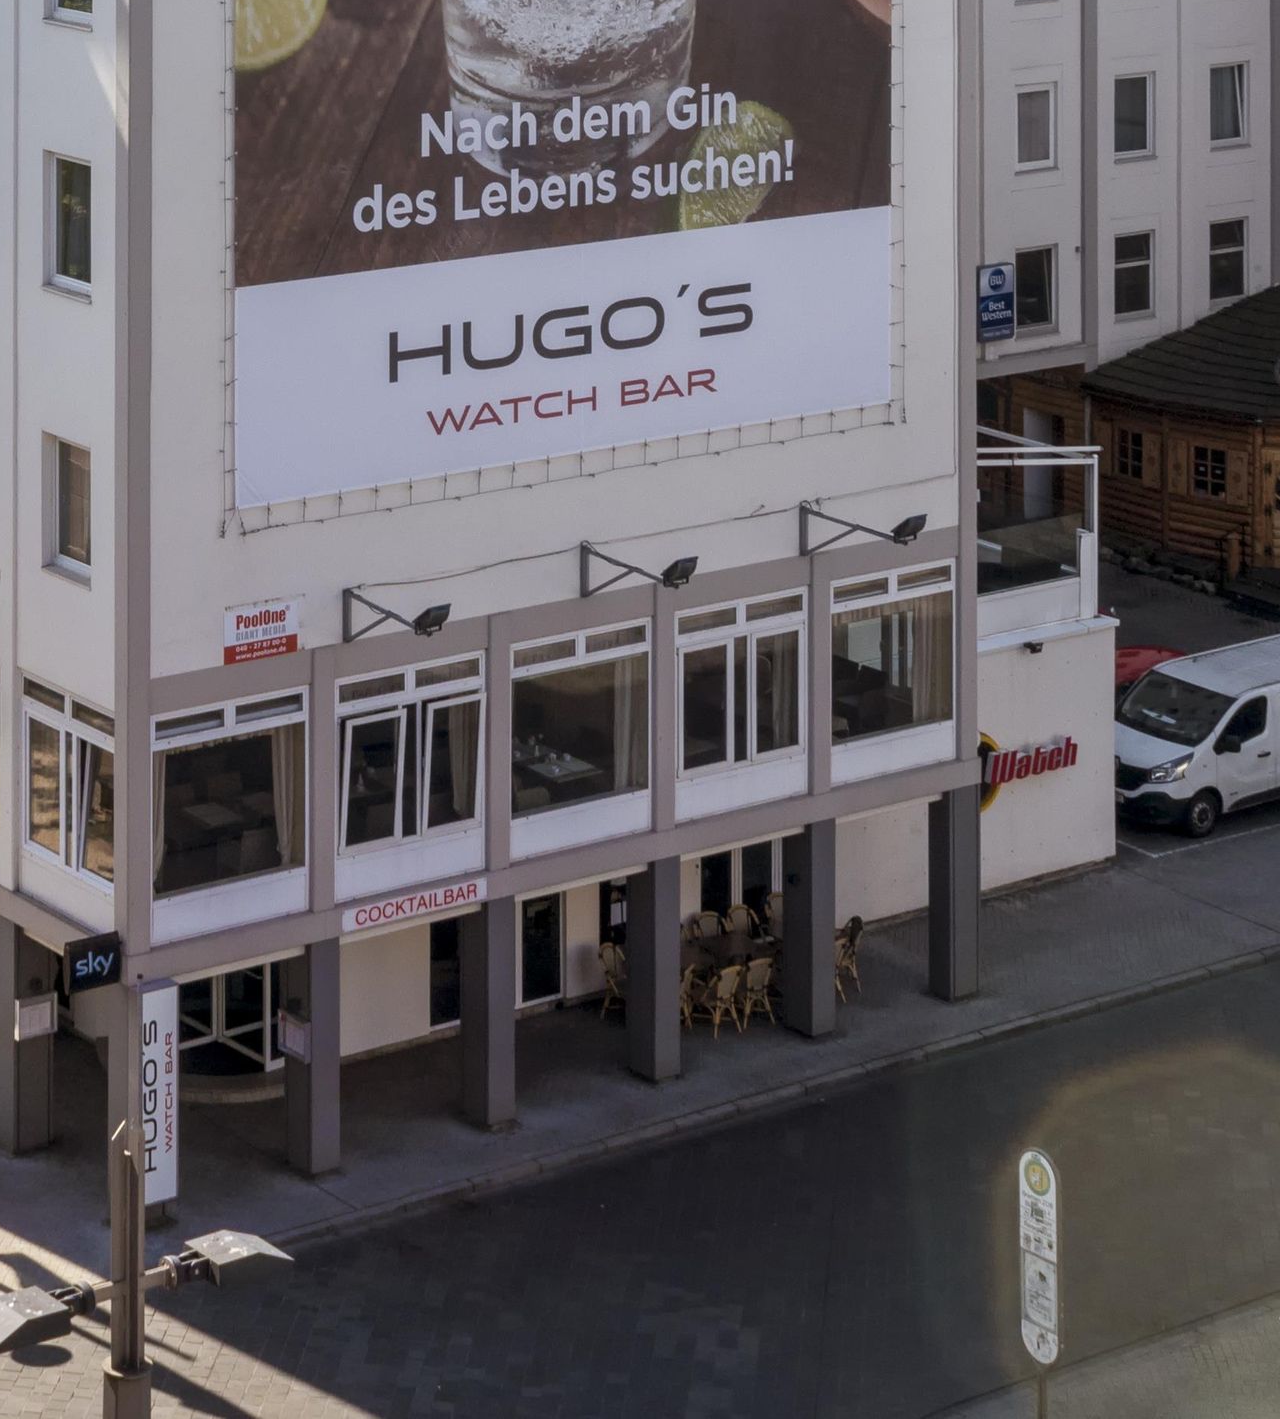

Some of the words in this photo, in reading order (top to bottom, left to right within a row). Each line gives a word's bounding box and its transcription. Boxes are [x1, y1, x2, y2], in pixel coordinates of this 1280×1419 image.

[421, 102, 537, 157] Nach
[553, 96, 651, 142] dem
[666, 83, 737, 131] Gin
[353, 184, 437, 232] des
[454, 168, 617, 220] Lebens
[631, 139, 794, 200] suchen!
[982, 309, 1012, 321] Western
[989, 301, 1005, 312] Best
[426, 386, 597, 435] WATCH
[621, 369, 717, 406] BAR
[236, 629, 259, 642] GIANT
[262, 624, 287, 637] MEDIA
[990, 736, 1078, 787] Watch
[355, 883, 478, 926] COCKTAILBAR
[76, 951, 114, 977] sky
[165, 1031, 174, 1075] BAR
[165, 1082, 173, 1154] WATCH
